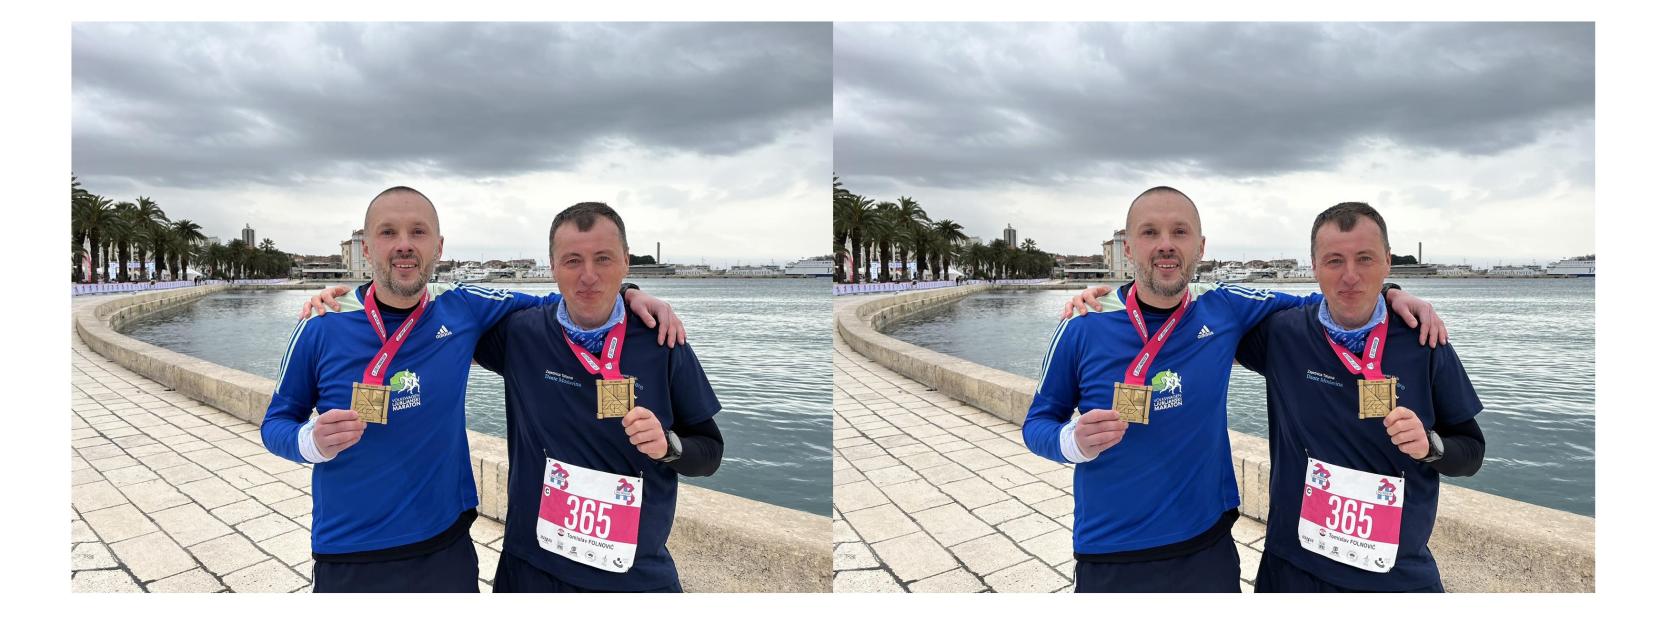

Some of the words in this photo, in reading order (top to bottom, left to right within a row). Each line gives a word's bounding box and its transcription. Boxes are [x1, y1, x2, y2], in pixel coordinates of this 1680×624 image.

[392, 402, 421, 411] MARATON
[1154, 402, 1183, 411] MARATON
[564, 495, 612, 539] 365
[1326, 495, 1374, 539] 365
[567, 533, 587, 544] Tomislav
[1329, 533, 1349, 544] Tomislav
